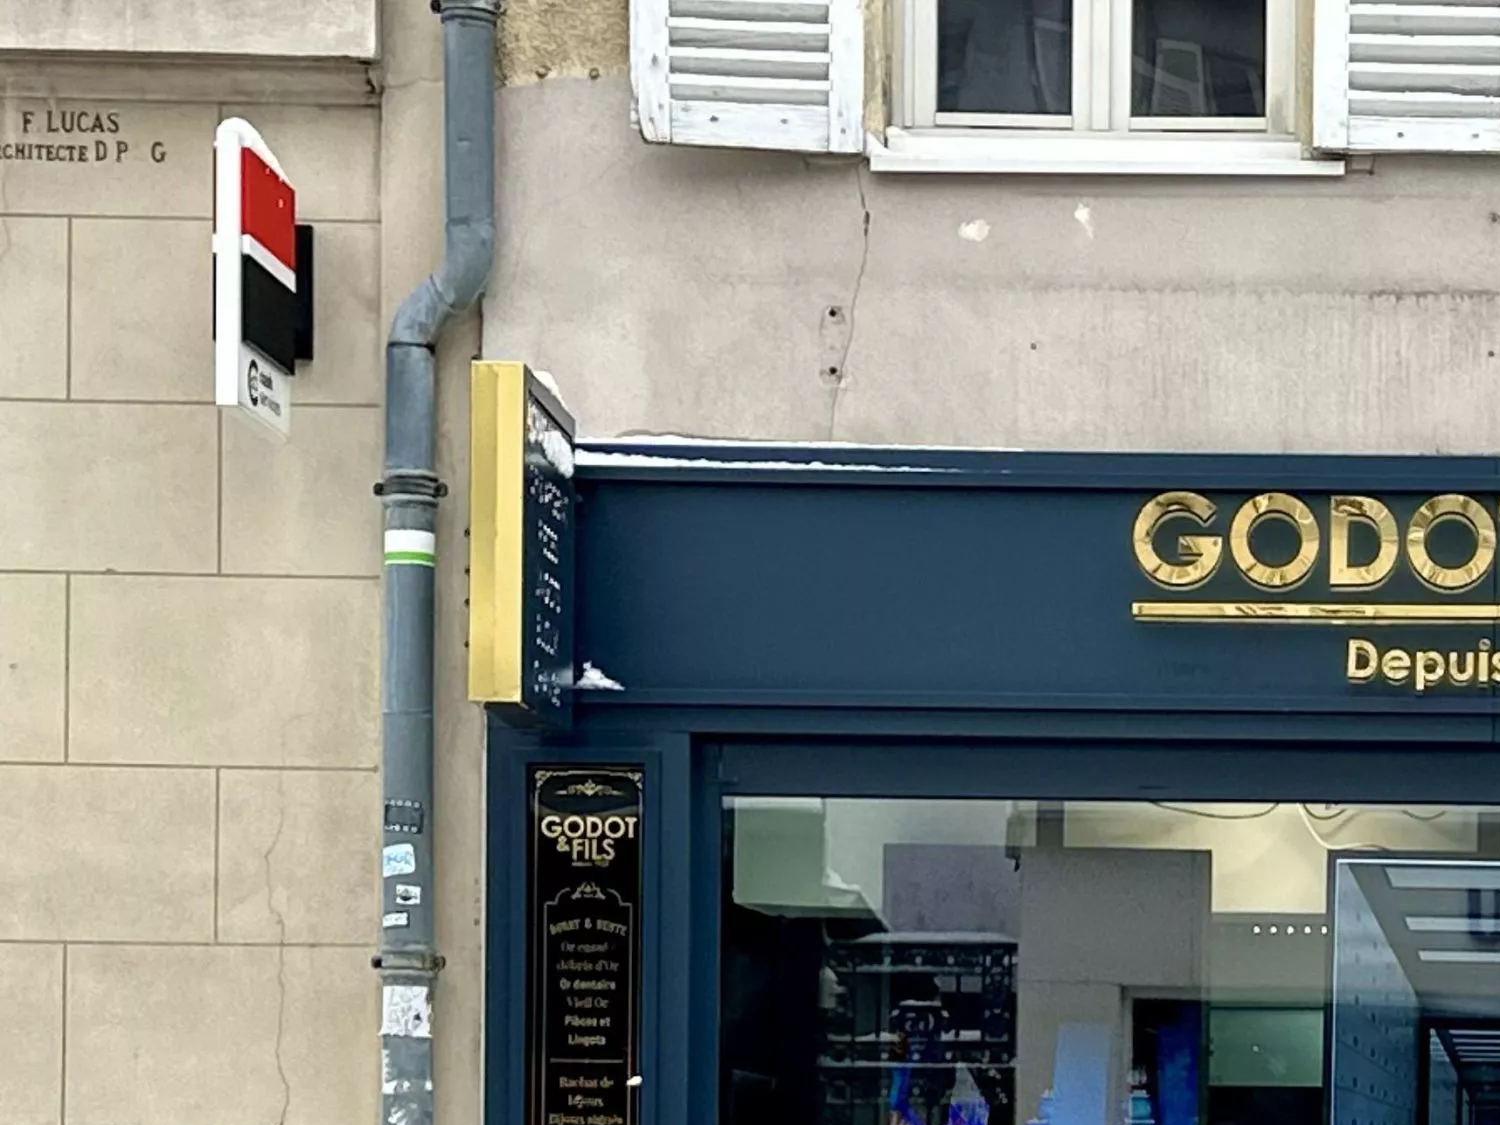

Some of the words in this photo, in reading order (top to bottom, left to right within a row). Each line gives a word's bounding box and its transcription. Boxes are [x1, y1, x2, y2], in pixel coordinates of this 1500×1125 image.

[22, 110, 35, 134] F
[47, 110, 120, 134] LUCAS
[0, 143, 89, 162] CHITECTE
[94, 140, 108, 162] D
[116, 140, 129, 162] P
[151, 141, 167, 163] G
[541, 816, 638, 839] GODOT
[556, 836, 570, 852] &
[572, 838, 615, 861] FILS
